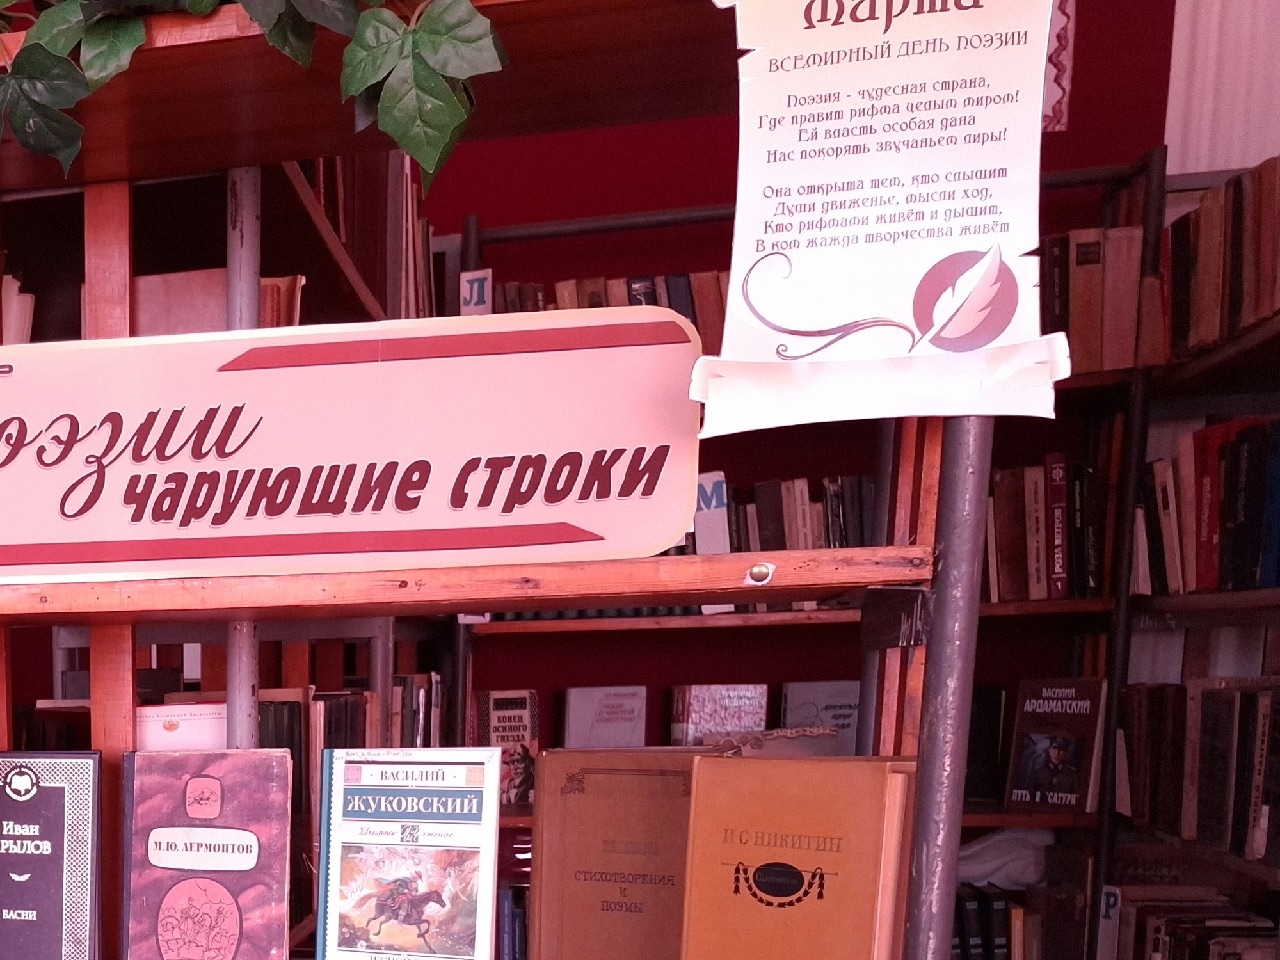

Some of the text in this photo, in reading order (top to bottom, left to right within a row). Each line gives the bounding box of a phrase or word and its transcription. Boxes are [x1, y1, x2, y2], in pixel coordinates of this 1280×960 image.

[768, 30, 1028, 73] ВСЕМИРНЫЙ ДЕНЬ ПОЭЗИИ
[786, 75, 990, 109] Поэзия чудесная страна,
[758, 90, 1020, 131] Где правит рифма целым миром!
[798, 113, 977, 143] Ей власть особая дана
[766, 127, 1007, 164] Нас покорять звучаньем лиры!
[762, 165, 1008, 199] Она открыта тем, кто слышит
[774, 184, 993, 217] Души движенье, мысли ход,
[763, 202, 1002, 235] Кто рифмами живёт и дышит,
[755, 220, 1010, 253] В ком жажда творчества живёт
[462, 277, 488, 306] Л
[123, 444, 670, 528] чарующие строки
[696, 481, 728, 511] М
[496, 715, 524, 724] КОНЕЦ
[1024, 699, 1090, 715] АРДАМАТСКИЙ
[492, 724, 528, 733] ОСИНОГО
[380, 769, 446, 781] ВАСИЛИЙ
[346, 794, 478, 814] ЖУКОВСКИЙ
[2, 821, 40, 836] Иван
[182, 840, 253, 855] ЛЕРМОНТОВ
[753, 831, 843, 853] НИКИТИН
[574, 869, 677, 887] СТИХОТВОРЕНИЯ
[619, 886, 628, 898] И
[2, 909, 37, 922] БАСНИ
[600, 900, 644, 914] ПОЭМЫ
